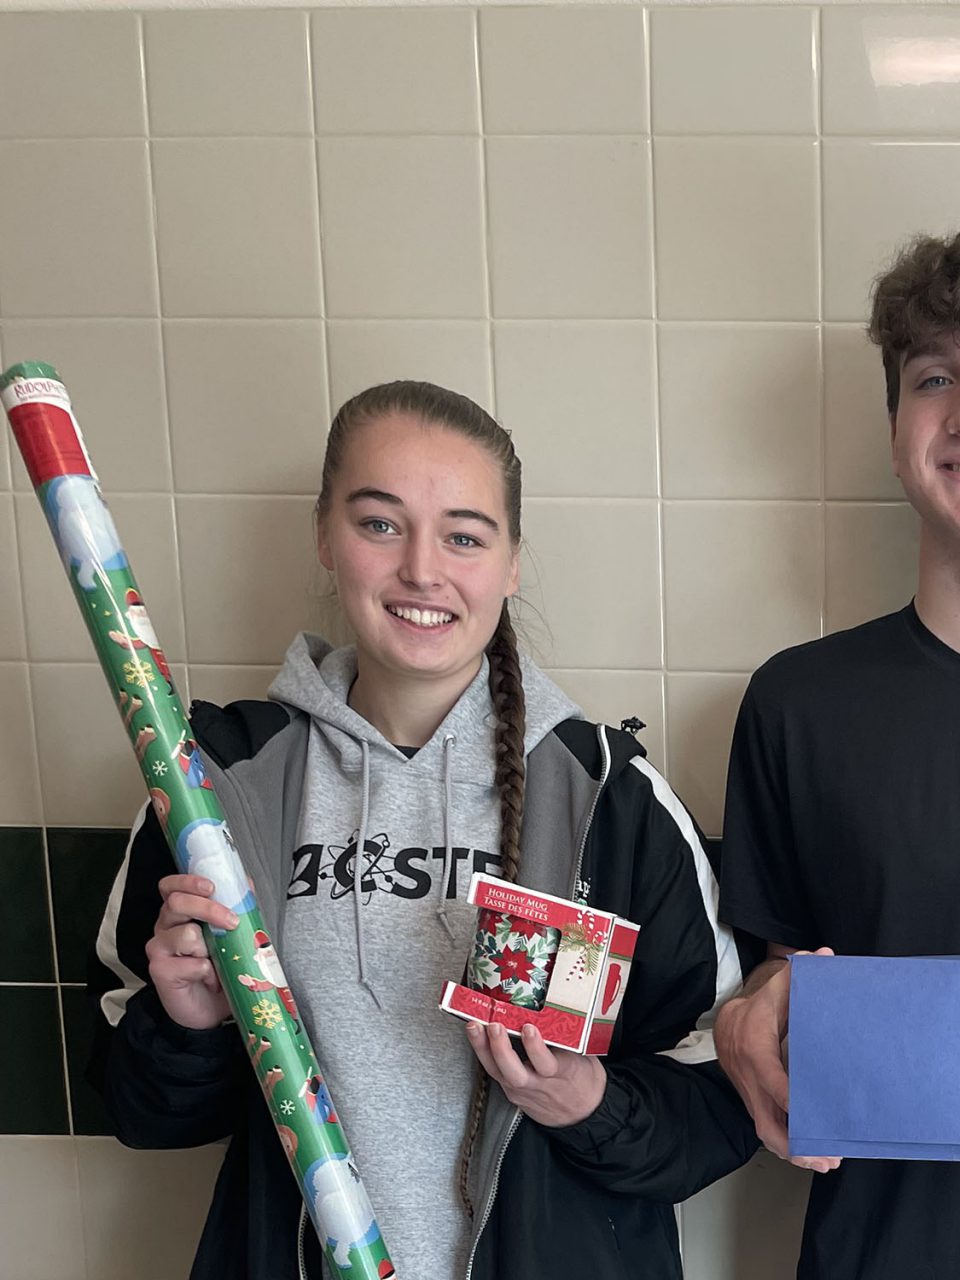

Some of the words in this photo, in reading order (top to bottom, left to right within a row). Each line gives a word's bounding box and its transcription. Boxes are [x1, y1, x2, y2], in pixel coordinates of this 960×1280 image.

[484, 896, 507, 909] TASSE
[508, 903, 523, 914] DES
[488, 887, 526, 904] HOLIDAY
[526, 898, 549, 912] MUG
